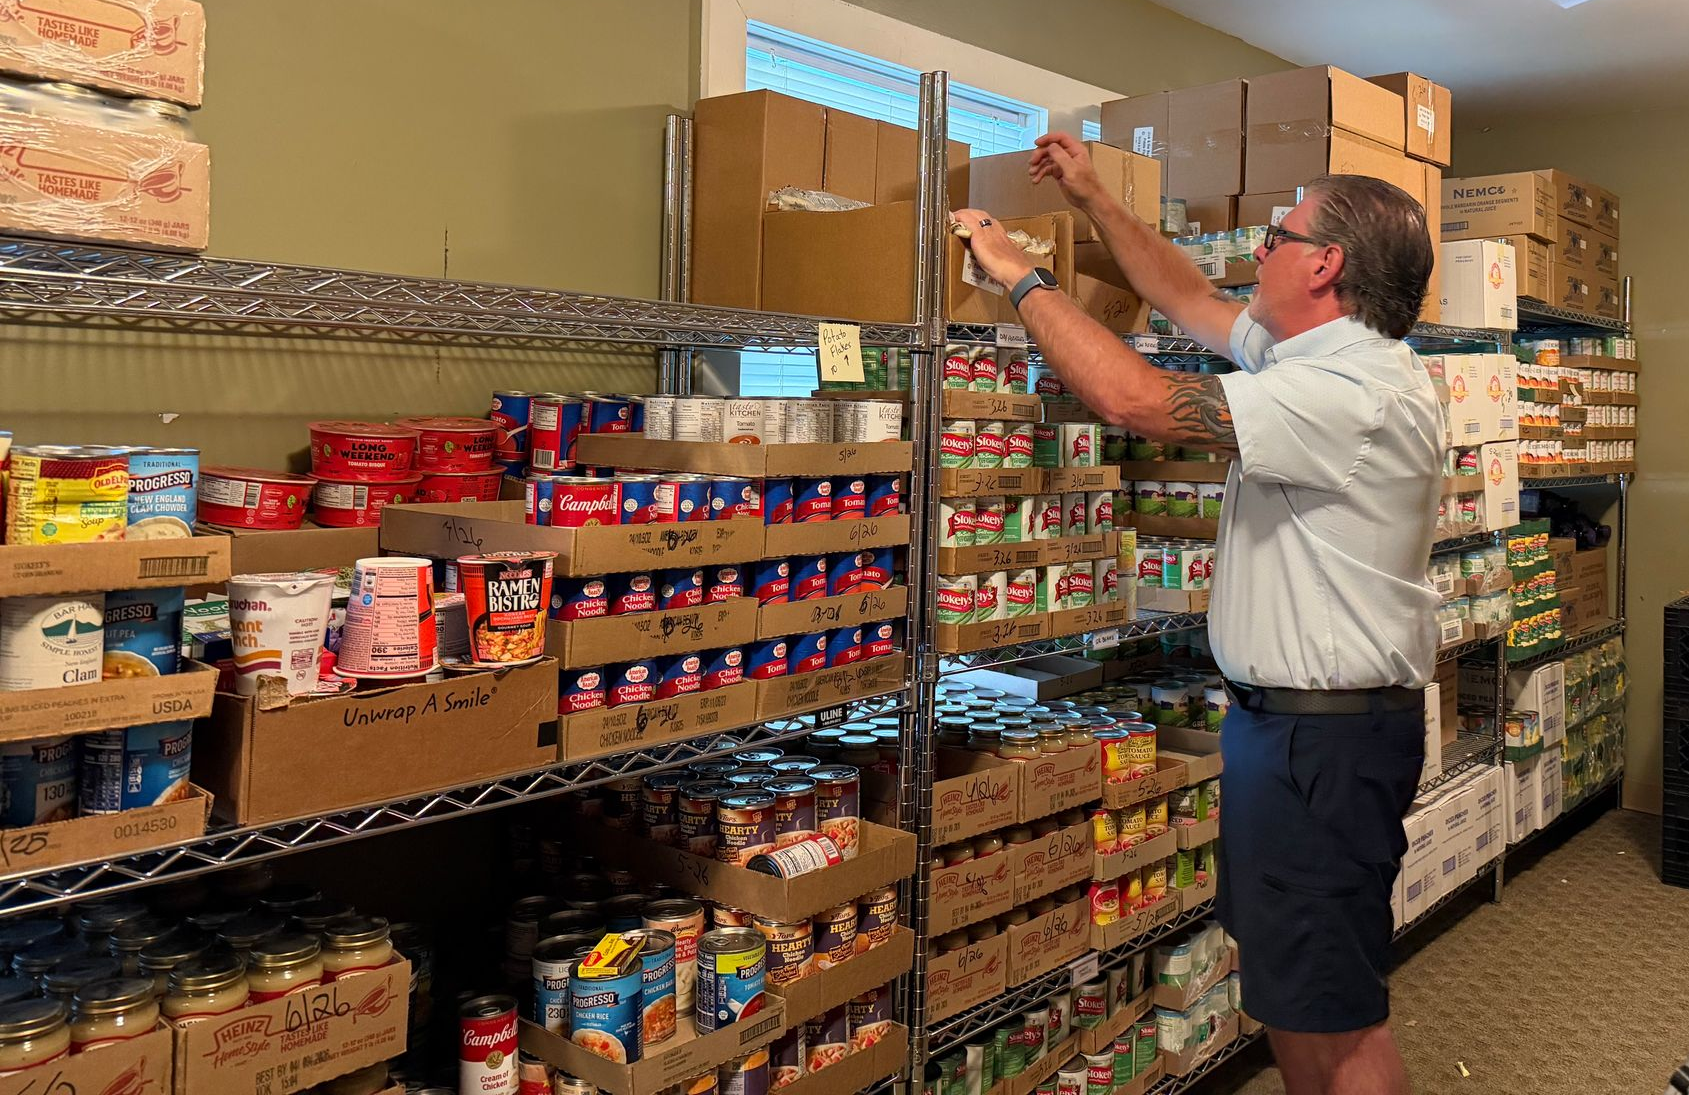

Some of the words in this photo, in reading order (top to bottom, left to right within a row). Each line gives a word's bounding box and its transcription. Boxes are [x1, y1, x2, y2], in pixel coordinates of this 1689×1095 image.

[37, 16, 77, 33] TASTES
[78, 26, 100, 38] LIKE
[37, 27, 98, 48] HOMEMADE
[37, 173, 78, 188] TASTES
[79, 179, 101, 191] LIKE
[38, 183, 100, 200] HOMEMADE
[1495, 197, 1519, 205] SEGMENTS
[822, 327, 847, 346] Potato
[829, 341, 852, 359] Flakes
[732, 401, 754, 412] taste
[729, 408, 762, 418] KITCHEN
[879, 411, 901, 420] KITCHE
[351, 442, 387, 452] LONG
[340, 450, 396, 462] WEEKEND
[838, 447, 856, 463] 5/26
[143, 460, 182, 468] TRADITIONAL
[94, 479, 111, 489] OLD
[111, 477, 120, 486] EL
[129, 471, 190, 492] PROGRESSO
[134, 495, 153, 504] NEW
[155, 494, 186, 504] ENGLAND
[130, 504, 153, 514] CLAM
[155, 502, 187, 512] CHOWDER
[80, 517, 105, 529] Soup
[849, 522, 878, 545] 6/26
[499, 569, 532, 580] NOODLES
[488, 577, 541, 597] RAMEN
[709, 585, 741, 595] Chicken
[488, 593, 540, 612] BISTRO
[575, 599, 608, 610] Chicken
[622, 594, 654, 605] Chicken
[53, 608, 75, 620] BAR
[77, 602, 97, 615] HA
[624, 601, 654, 611] Noodle
[105, 604, 151, 623] GRESSO
[577, 607, 606, 618] Noodle
[232, 620, 263, 633] ant
[119, 629, 136, 639] PEA
[233, 634, 259, 648] nch
[40, 641, 71, 657] SIMPLE
[371, 646, 388, 654] 390
[393, 644, 418, 652] Calories
[62, 667, 98, 684] Clam
[617, 685, 652, 695] Chicken
[98, 694, 125, 704] EXTRA
[569, 691, 604, 703] Chicken
[619, 691, 651, 702] Noodle
[152, 698, 193, 715] USDA
[343, 704, 416, 728] Unwrap
[421, 693, 443, 715] A
[571, 699, 602, 710] Noodle
[820, 707, 843, 722] ULINE
[39, 741, 73, 763] PROG
[1127, 746, 1153, 754] TOMATO
[1036, 765, 1053, 776] HEINZ
[43, 783, 65, 802] 130
[1138, 777, 1162, 798] 5-26
[942, 791, 961, 803] HEINZ
[113, 815, 177, 840] 0014530
[719, 825, 759, 835] HEARTY
[1047, 834, 1081, 859] 6/26
[1025, 854, 1043, 865] HEINZ
[938, 875, 957, 887] HEINZ
[1131, 909, 1160, 932] 5/26
[777, 931, 796, 940] Tops
[1023, 935, 1039, 946] HEINZ
[675, 938, 692, 946] Hearty
[771, 936, 812, 953] HEARTY
[782, 948, 806, 958] Chicken
[783, 954, 805, 964] Noodle
[958, 948, 983, 972] 6/26
[929, 974, 947, 985] HEINZ
[644, 983, 668, 996] CHICKEN
[572, 993, 615, 1009] PROGRESSO
[285, 986, 354, 1033] 6/26
[547, 1007, 566, 1019] 230
[575, 1012, 596, 1020] CHICKEN
[597, 1012, 609, 1020] RICE
[220, 1020, 265, 1044] HEINZ
[280, 1029, 310, 1044] TASTES
[311, 1021, 330, 1036] LIKE
[280, 1031, 328, 1054] HOMEMADE
[213, 1038, 272, 1070] HomeStyle
[255, 1068, 274, 1085] BEST
[276, 1066, 287, 1079] BY
[480, 1073, 502, 1084] Cream
[502, 1070, 509, 1078] of
[482, 1079, 508, 1091] Chicken
